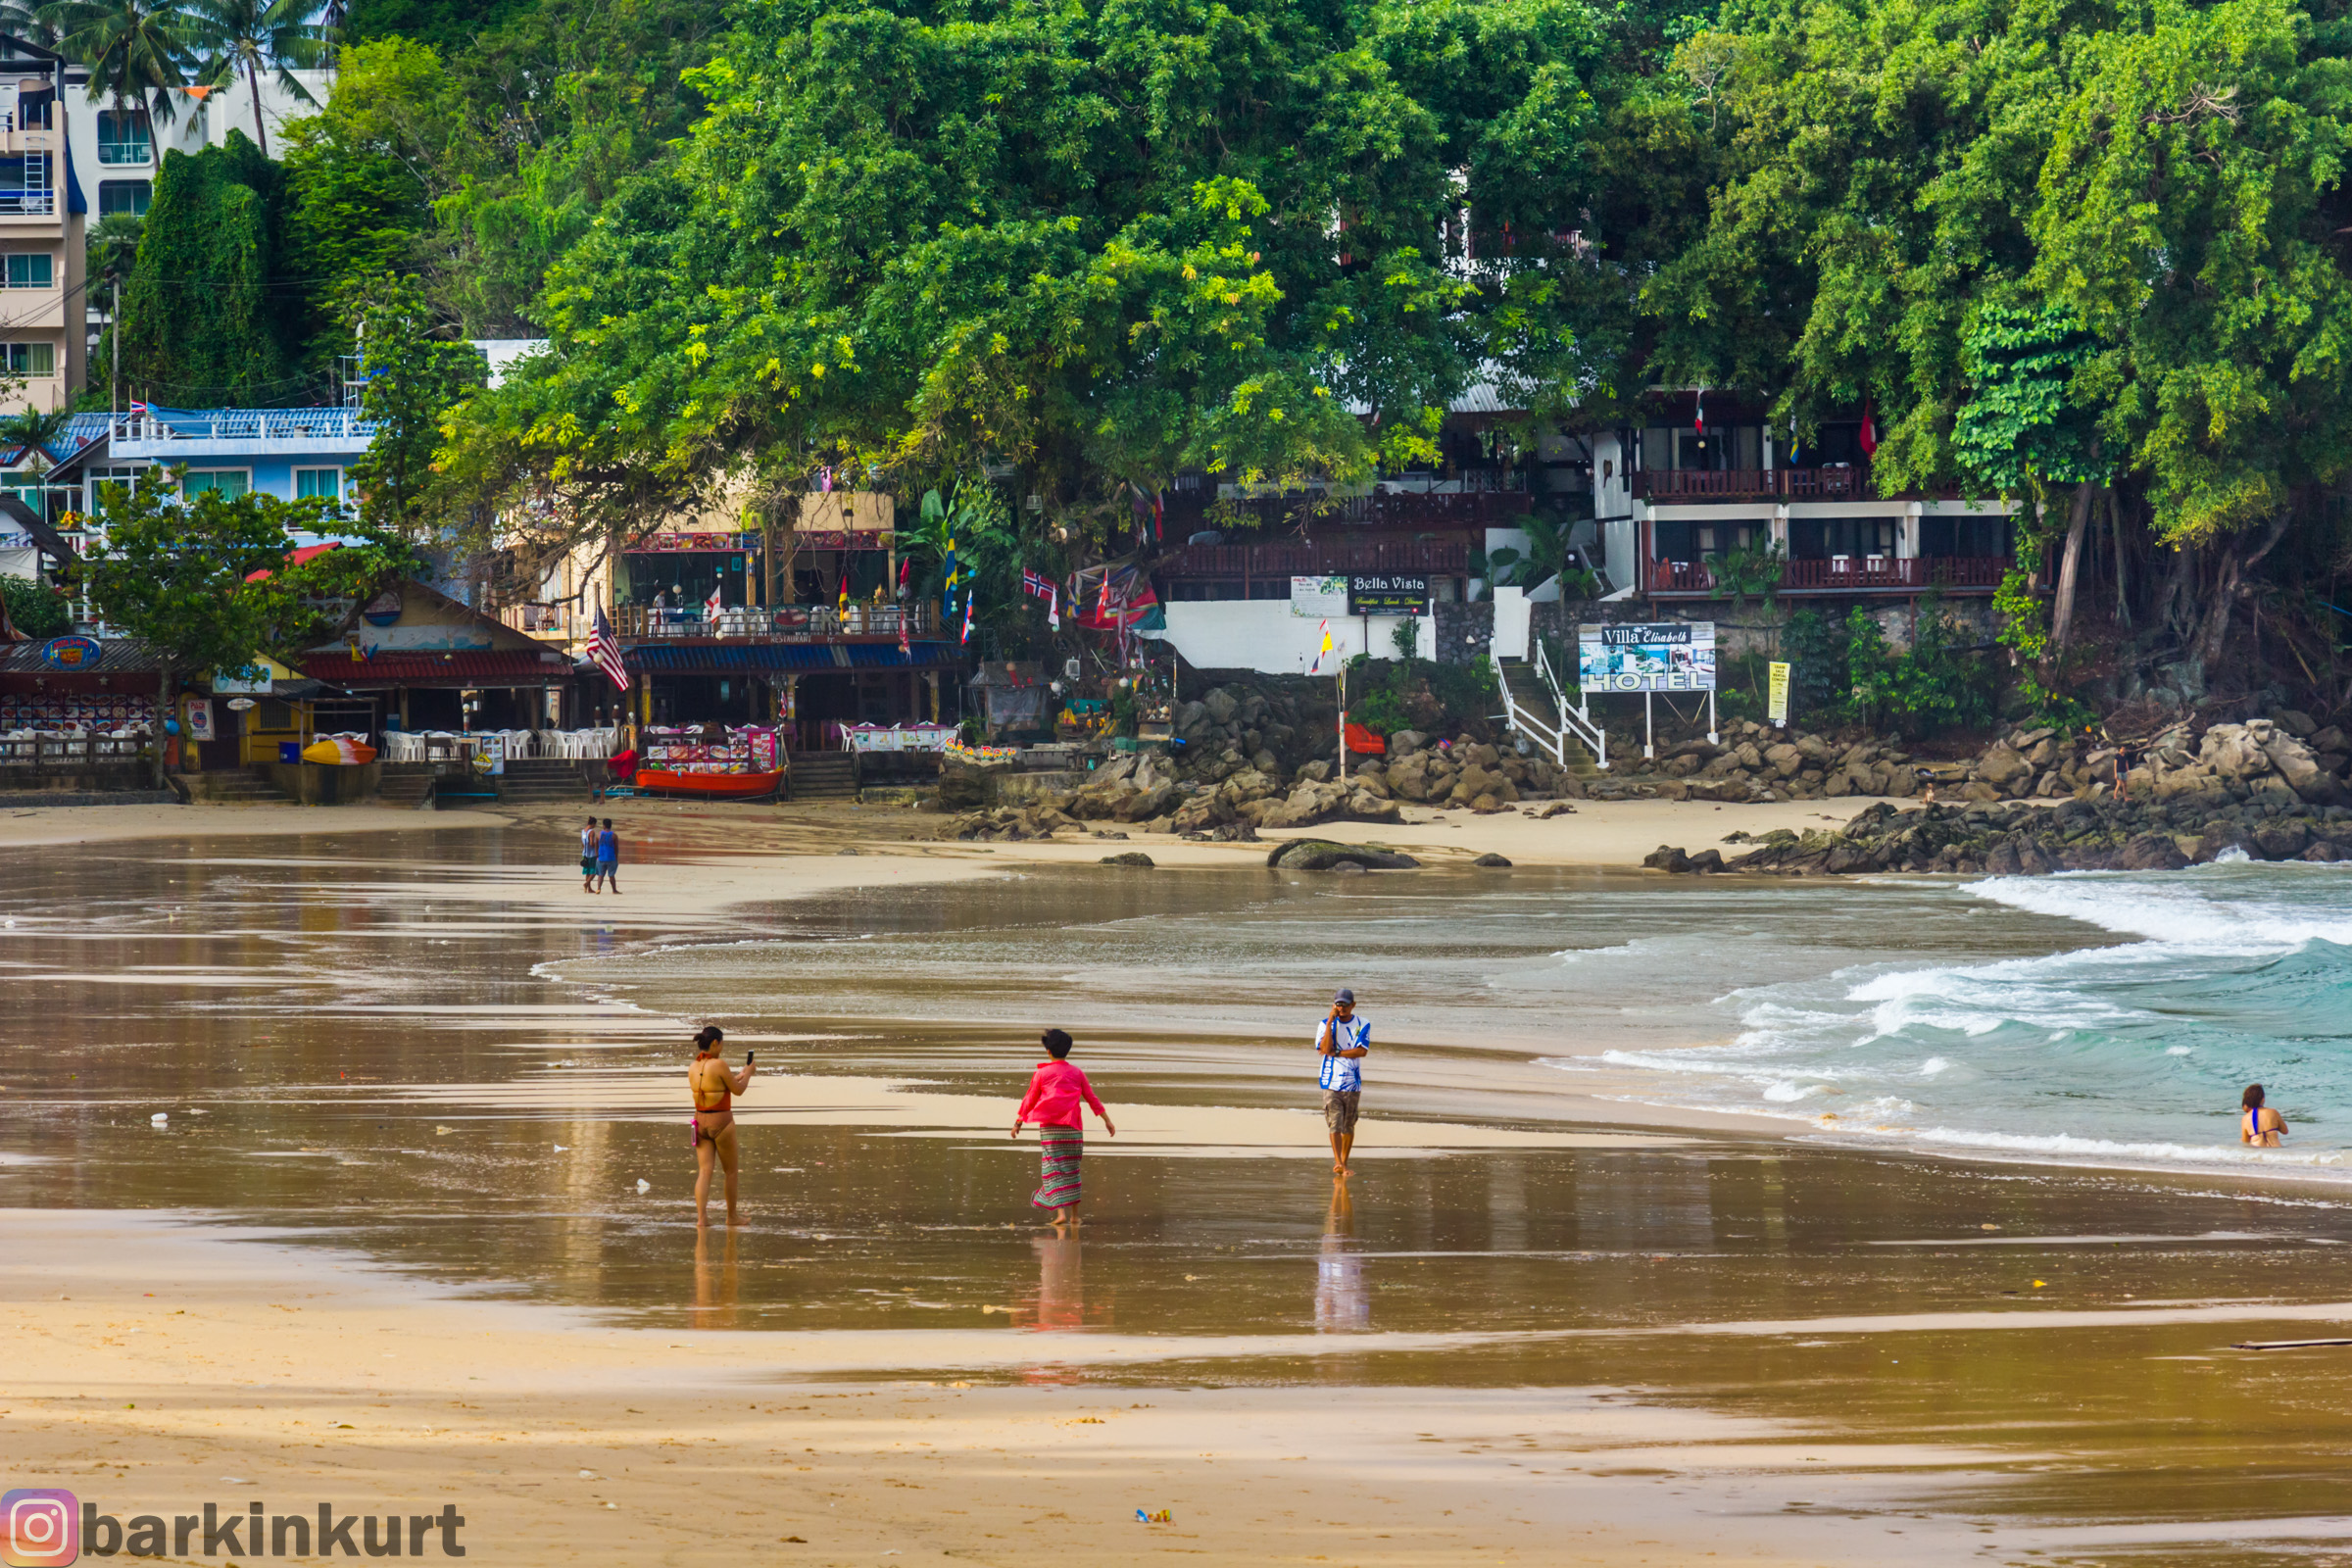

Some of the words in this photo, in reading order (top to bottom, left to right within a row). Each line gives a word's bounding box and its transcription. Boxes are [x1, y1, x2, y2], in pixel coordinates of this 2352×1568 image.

[1353, 576, 1388, 590] Bella
[1392, 576, 1425, 590] Vista
[1384, 596, 1399, 605] Lunch
[1404, 596, 1424, 605] Dinner
[770, 635, 811, 644] RESTAURANT
[1604, 629, 1640, 644] Villa
[1642, 629, 1687, 643] Elisabeth
[1587, 671, 1709, 691] HOTEL
[944, 737, 974, 759] Ska
[981, 745, 1017, 760] Bar
